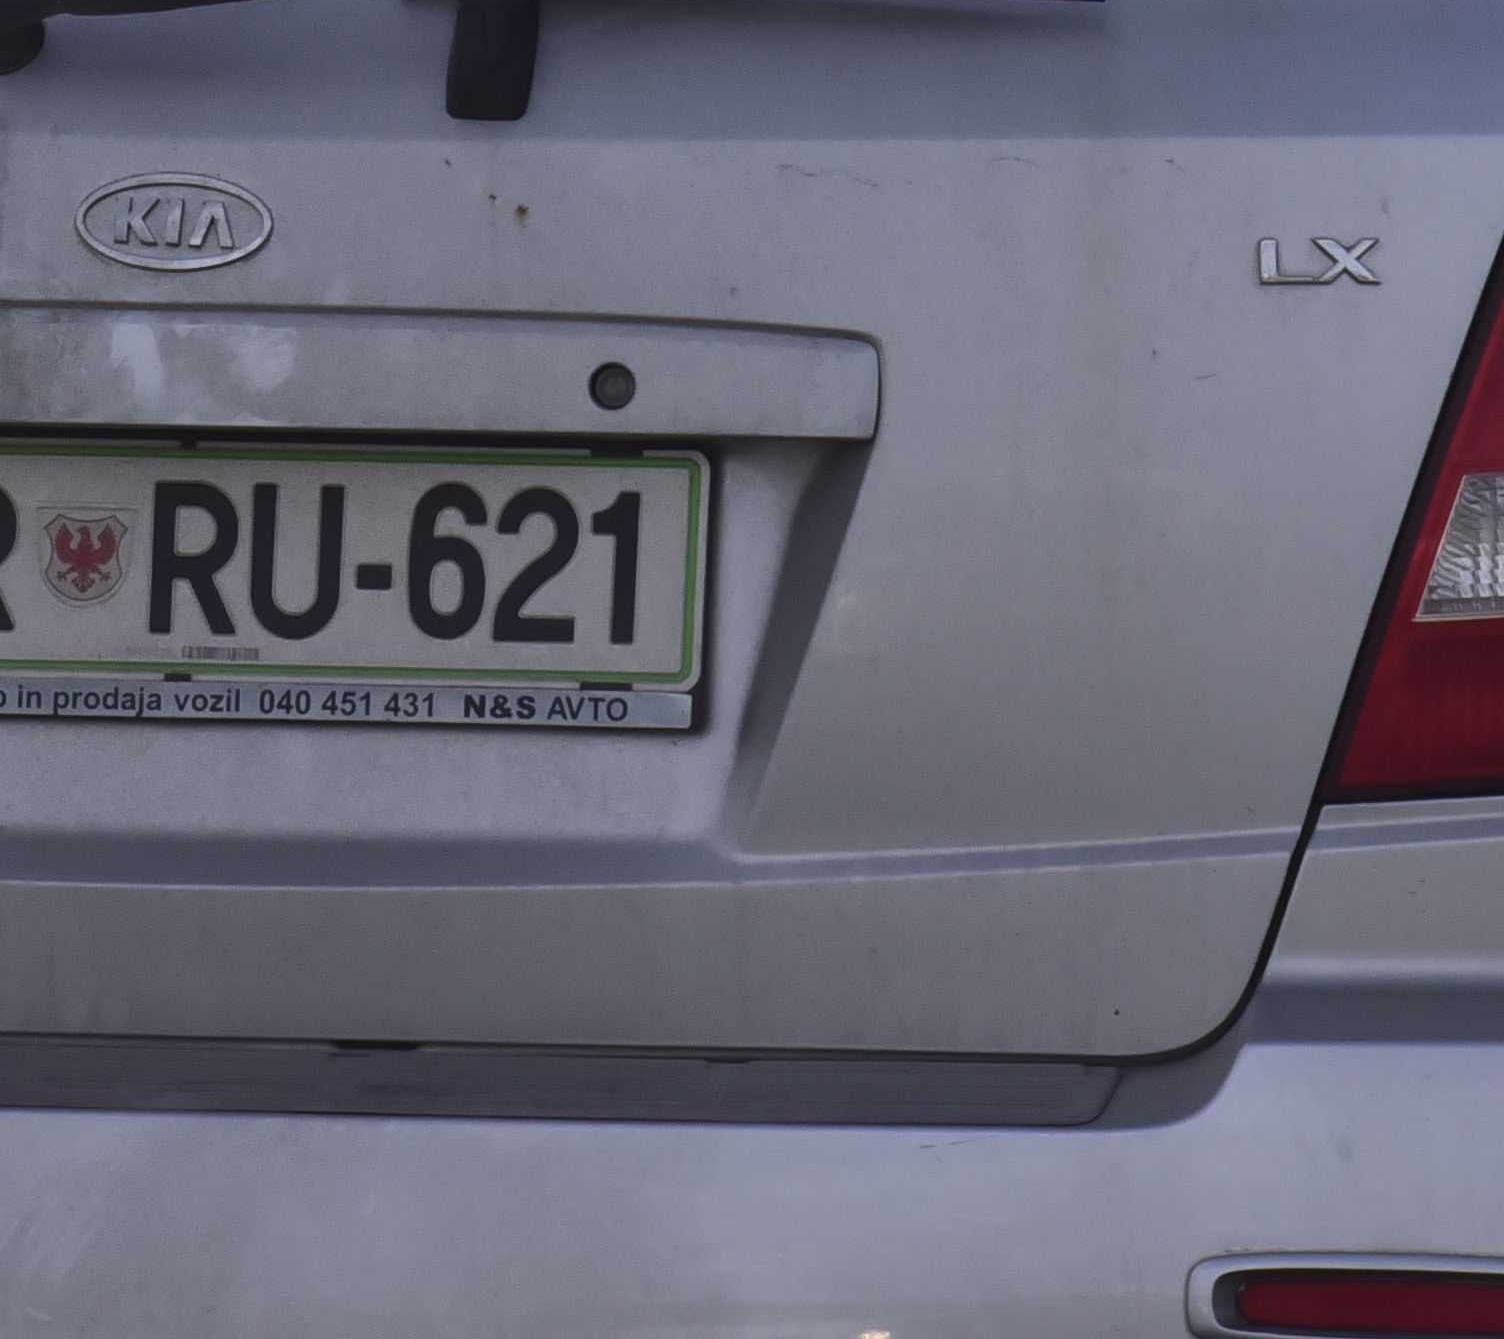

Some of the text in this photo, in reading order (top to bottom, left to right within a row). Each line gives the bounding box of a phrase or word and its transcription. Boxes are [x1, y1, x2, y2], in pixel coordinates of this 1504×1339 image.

[114, 196, 235, 249] KIA
[1258, 236, 1382, 286] LX
[148, 480, 643, 646] RU-621
[18, 685, 42, 709] in
[52, 686, 163, 717] prodaja
[174, 689, 241, 713] vozil
[258, 689, 312, 715] 040
[321, 690, 373, 717] 451
[384, 691, 436, 718] 431
[463, 693, 537, 719] N&S
[546, 696, 629, 722] AVTO
